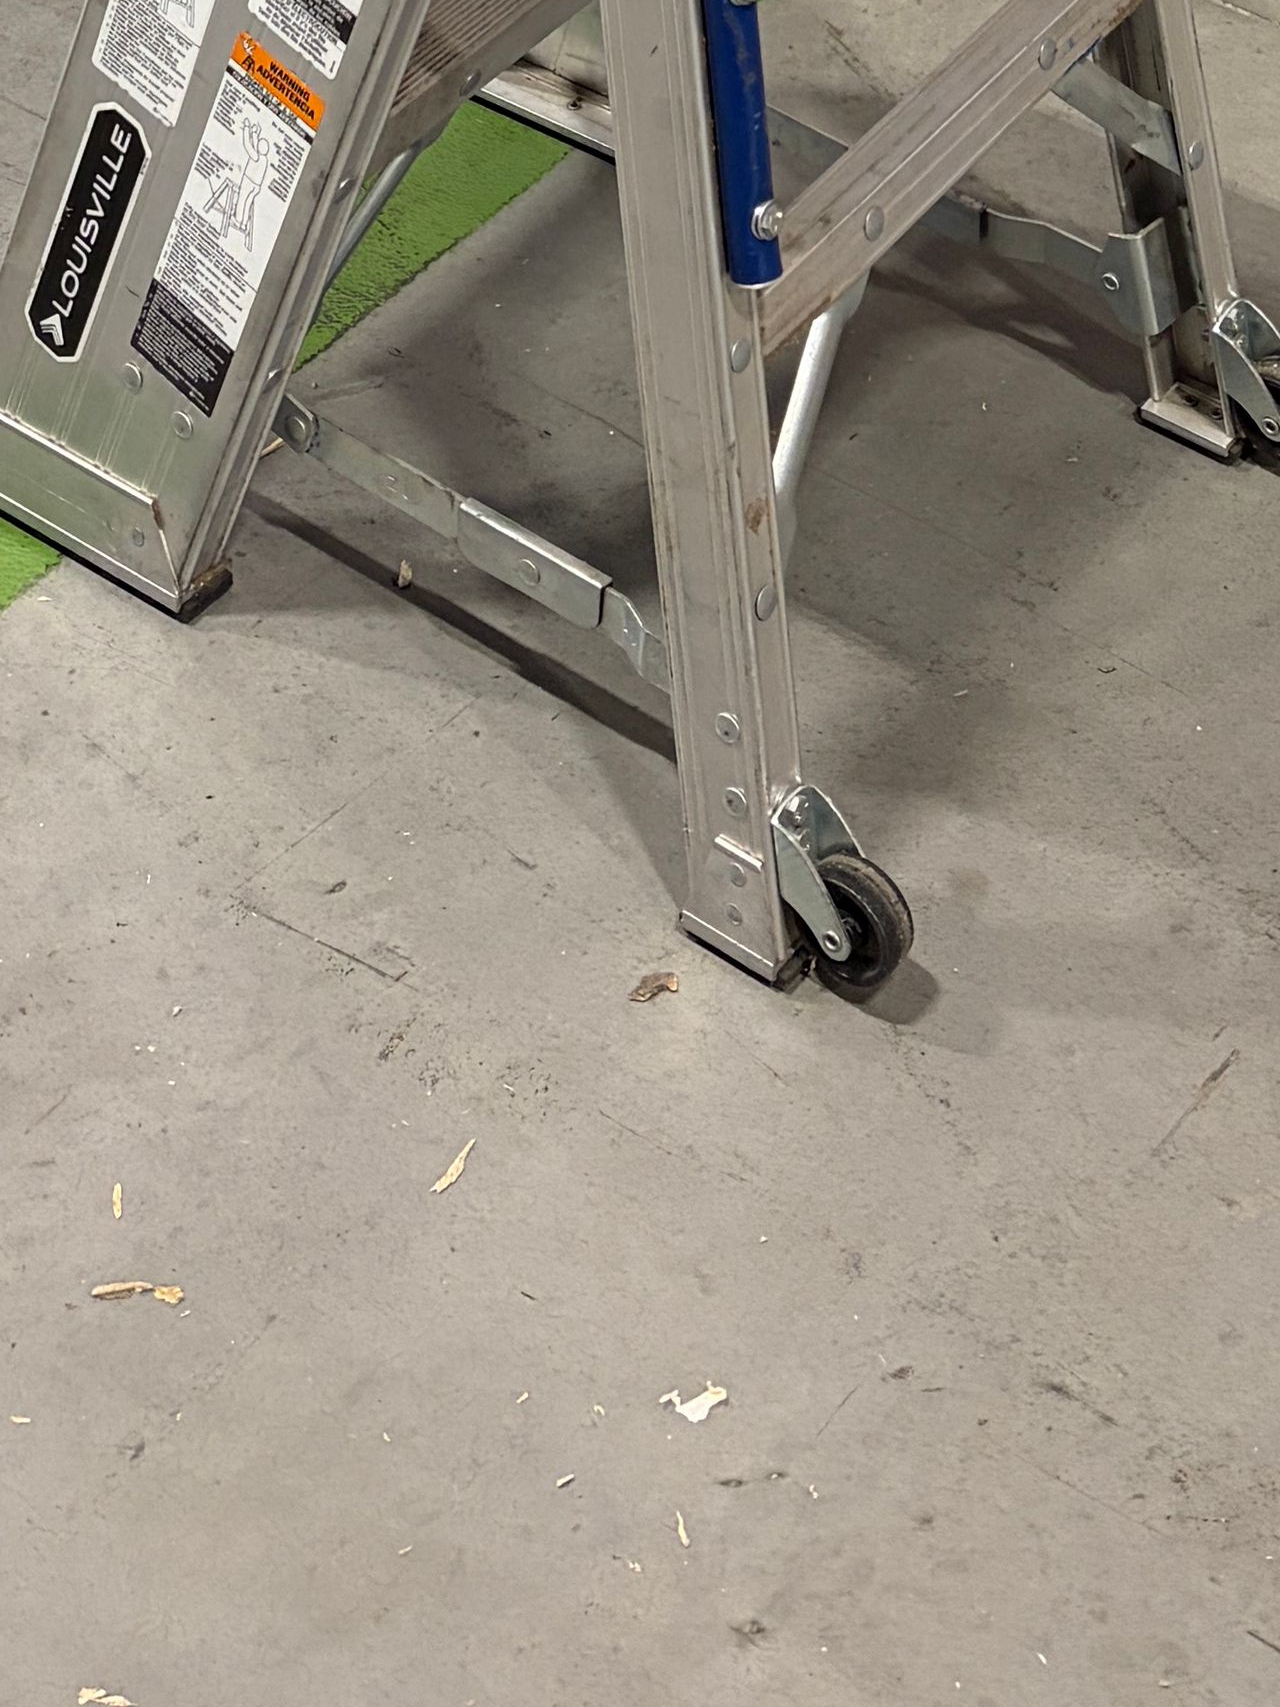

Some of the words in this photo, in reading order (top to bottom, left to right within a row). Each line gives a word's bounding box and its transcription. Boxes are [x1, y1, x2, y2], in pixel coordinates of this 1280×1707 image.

[255, 60, 316, 123] ADVERTENCIA
[268, 58, 311, 104] WARNING
[52, 123, 133, 318] LOUISVILLE
